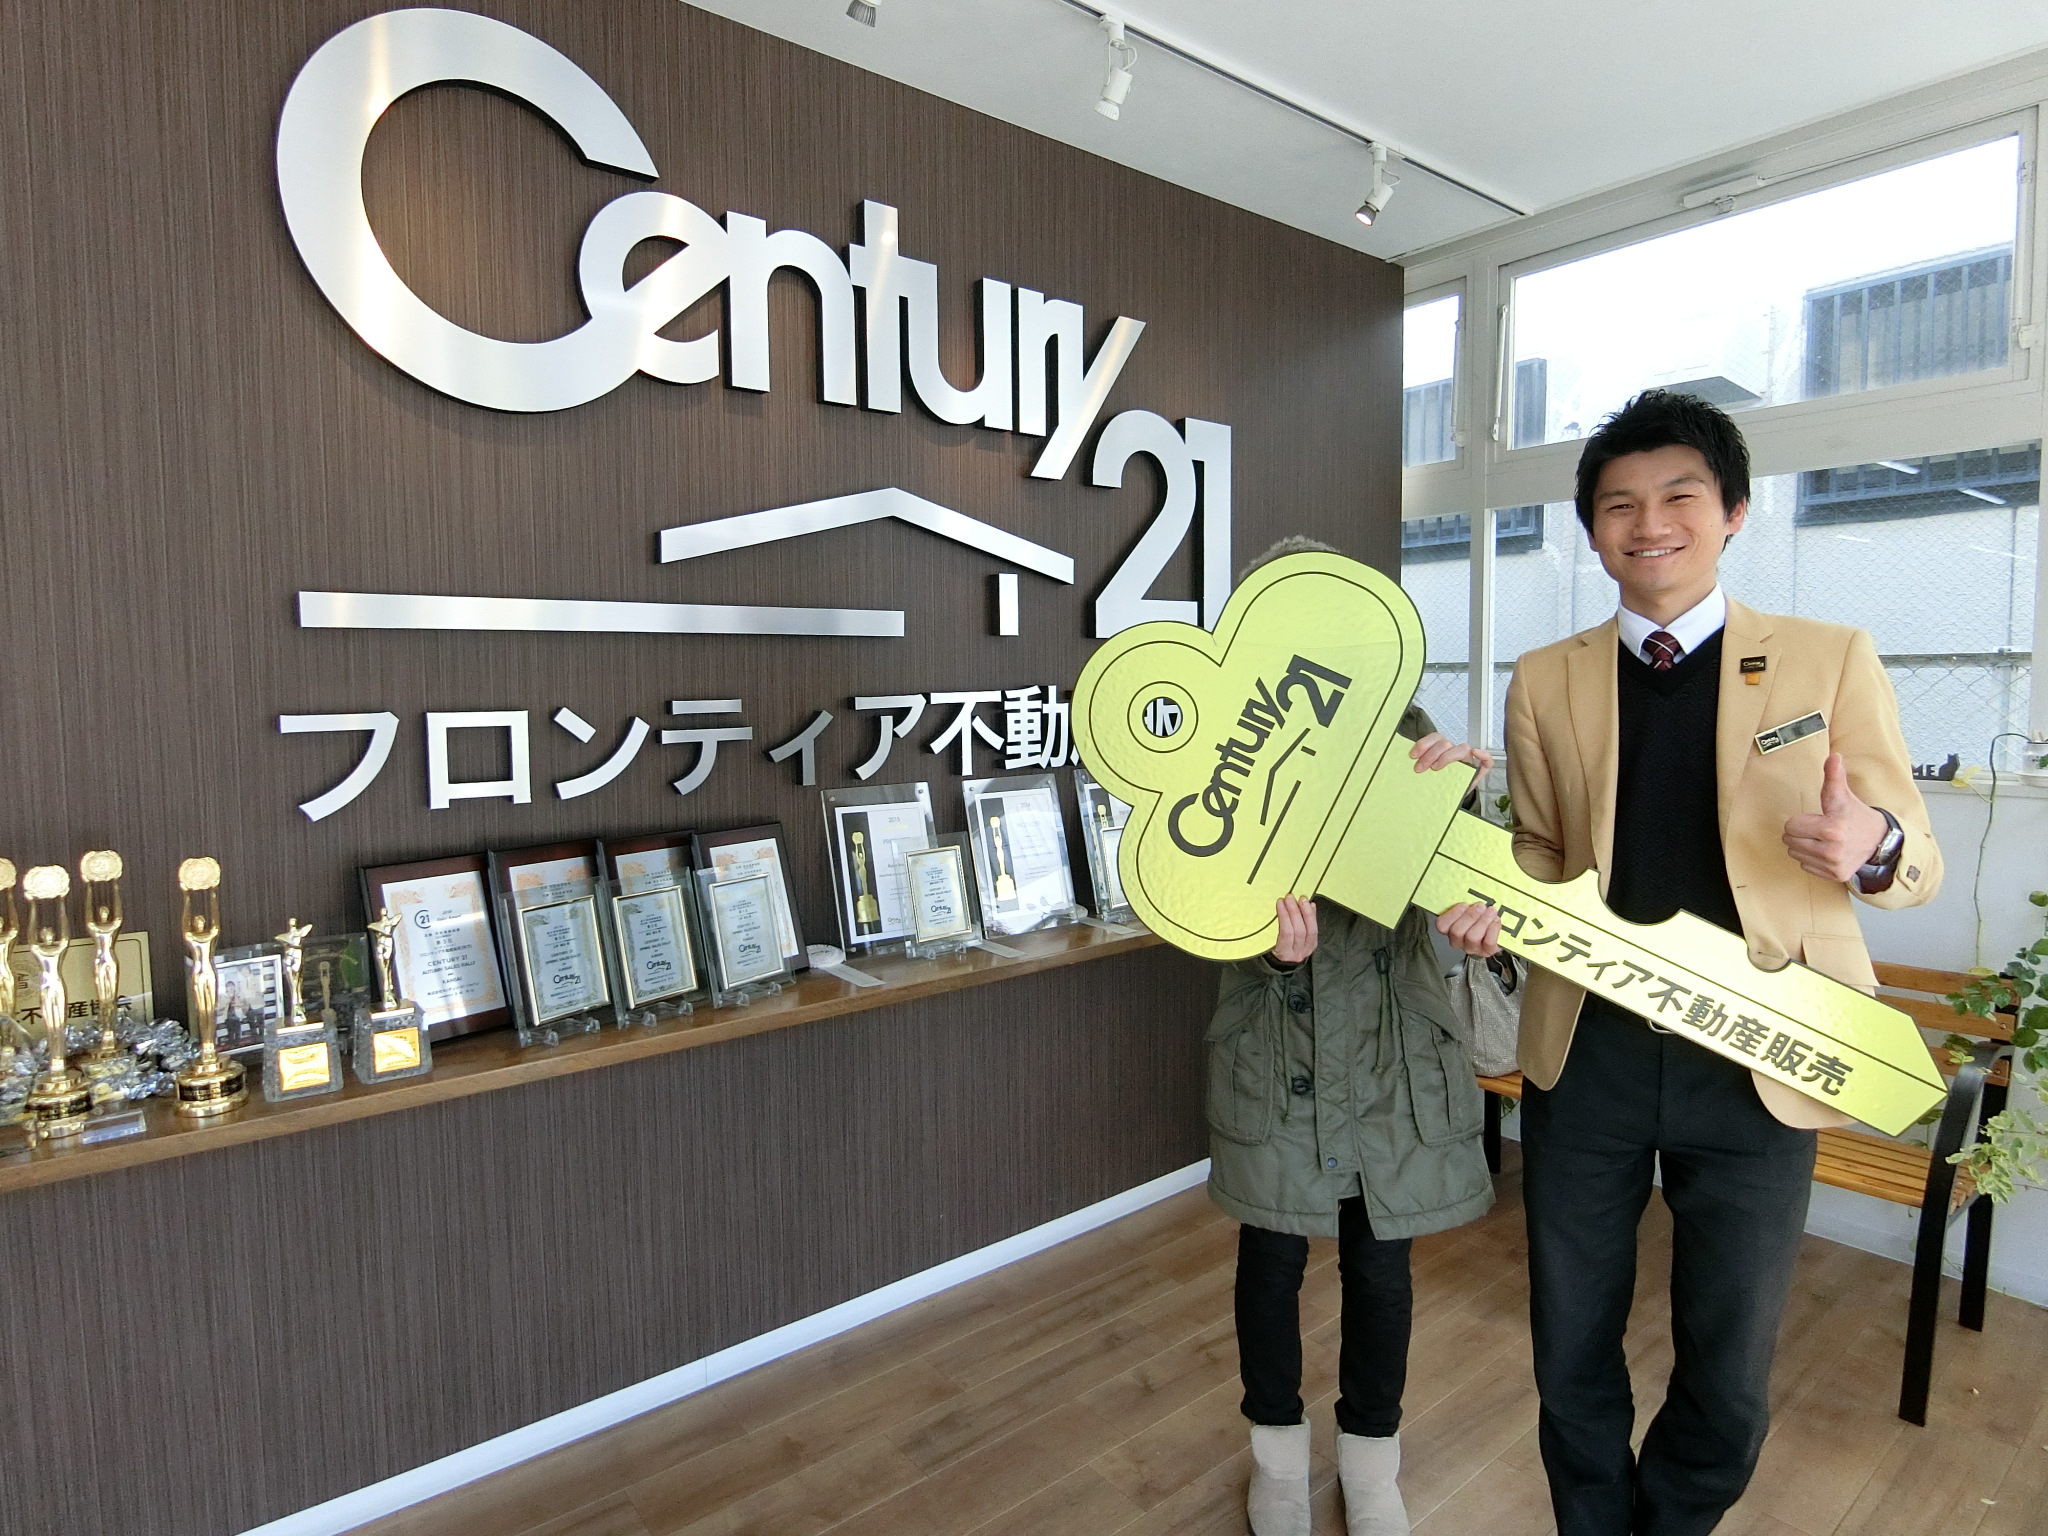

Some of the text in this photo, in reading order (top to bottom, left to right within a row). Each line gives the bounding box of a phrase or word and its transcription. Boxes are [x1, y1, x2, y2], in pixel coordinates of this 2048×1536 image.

[276, 7, 1232, 639] Century 21
[1168, 654, 1353, 857] Century 21
[427, 956, 461, 967] CENTURY
